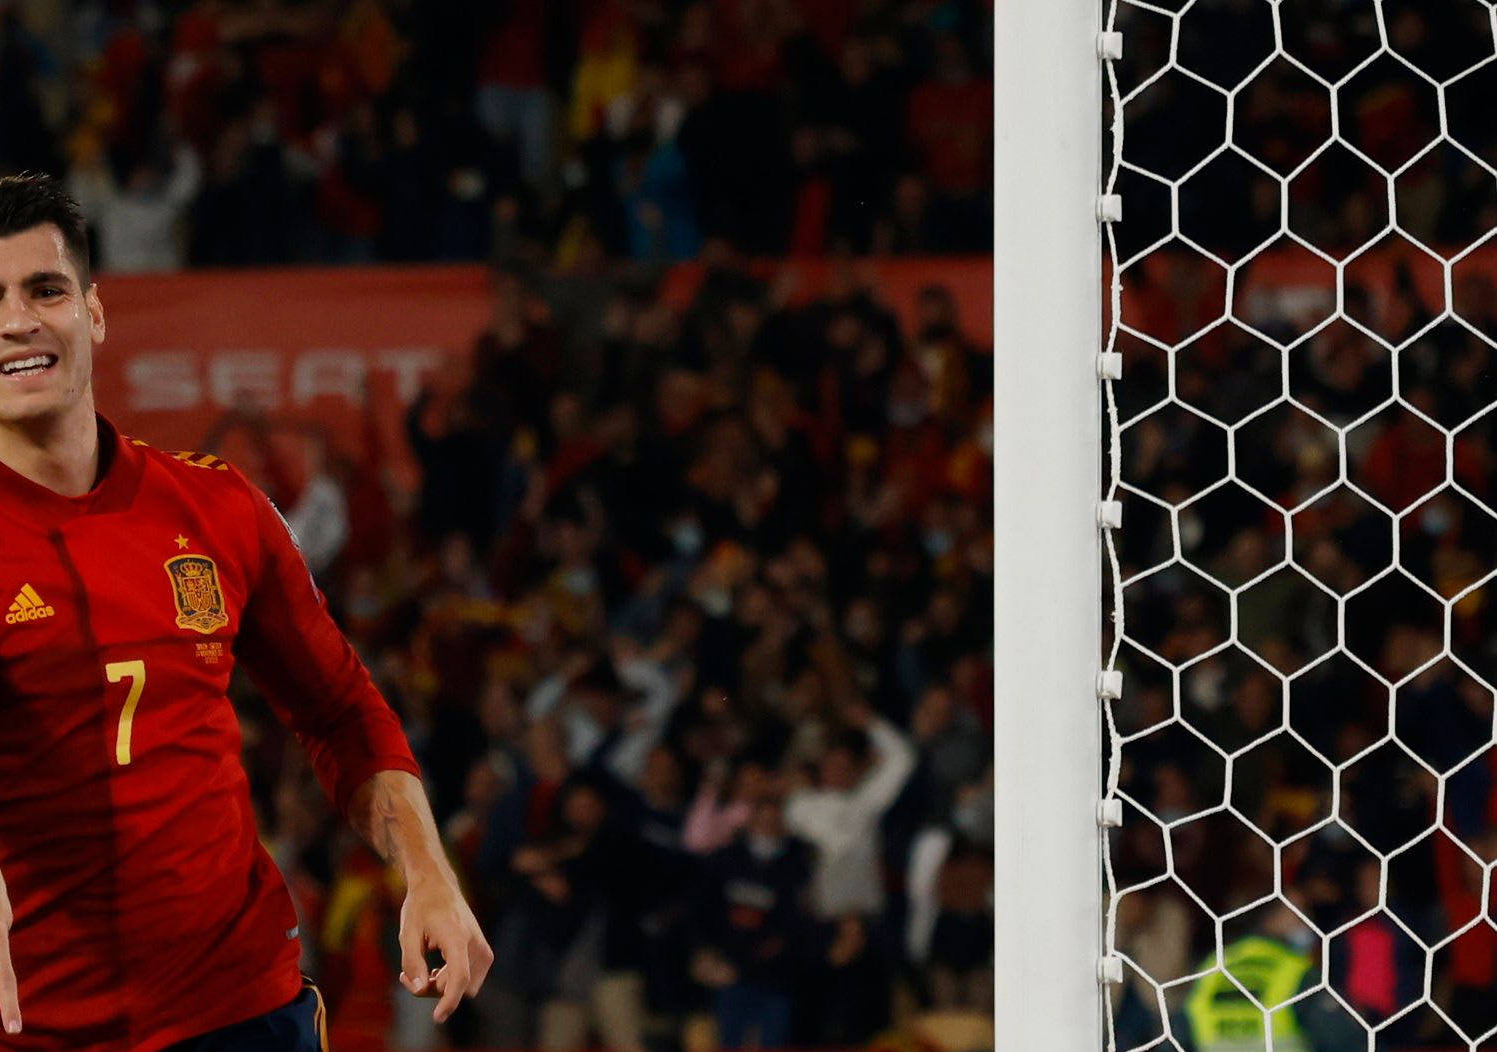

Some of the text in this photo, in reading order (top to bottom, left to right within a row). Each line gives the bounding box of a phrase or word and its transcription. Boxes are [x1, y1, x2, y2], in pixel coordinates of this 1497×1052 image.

[127, 351, 443, 409] SEAT
[5, 605, 55, 625] adidas
[105, 659, 146, 766] 7
